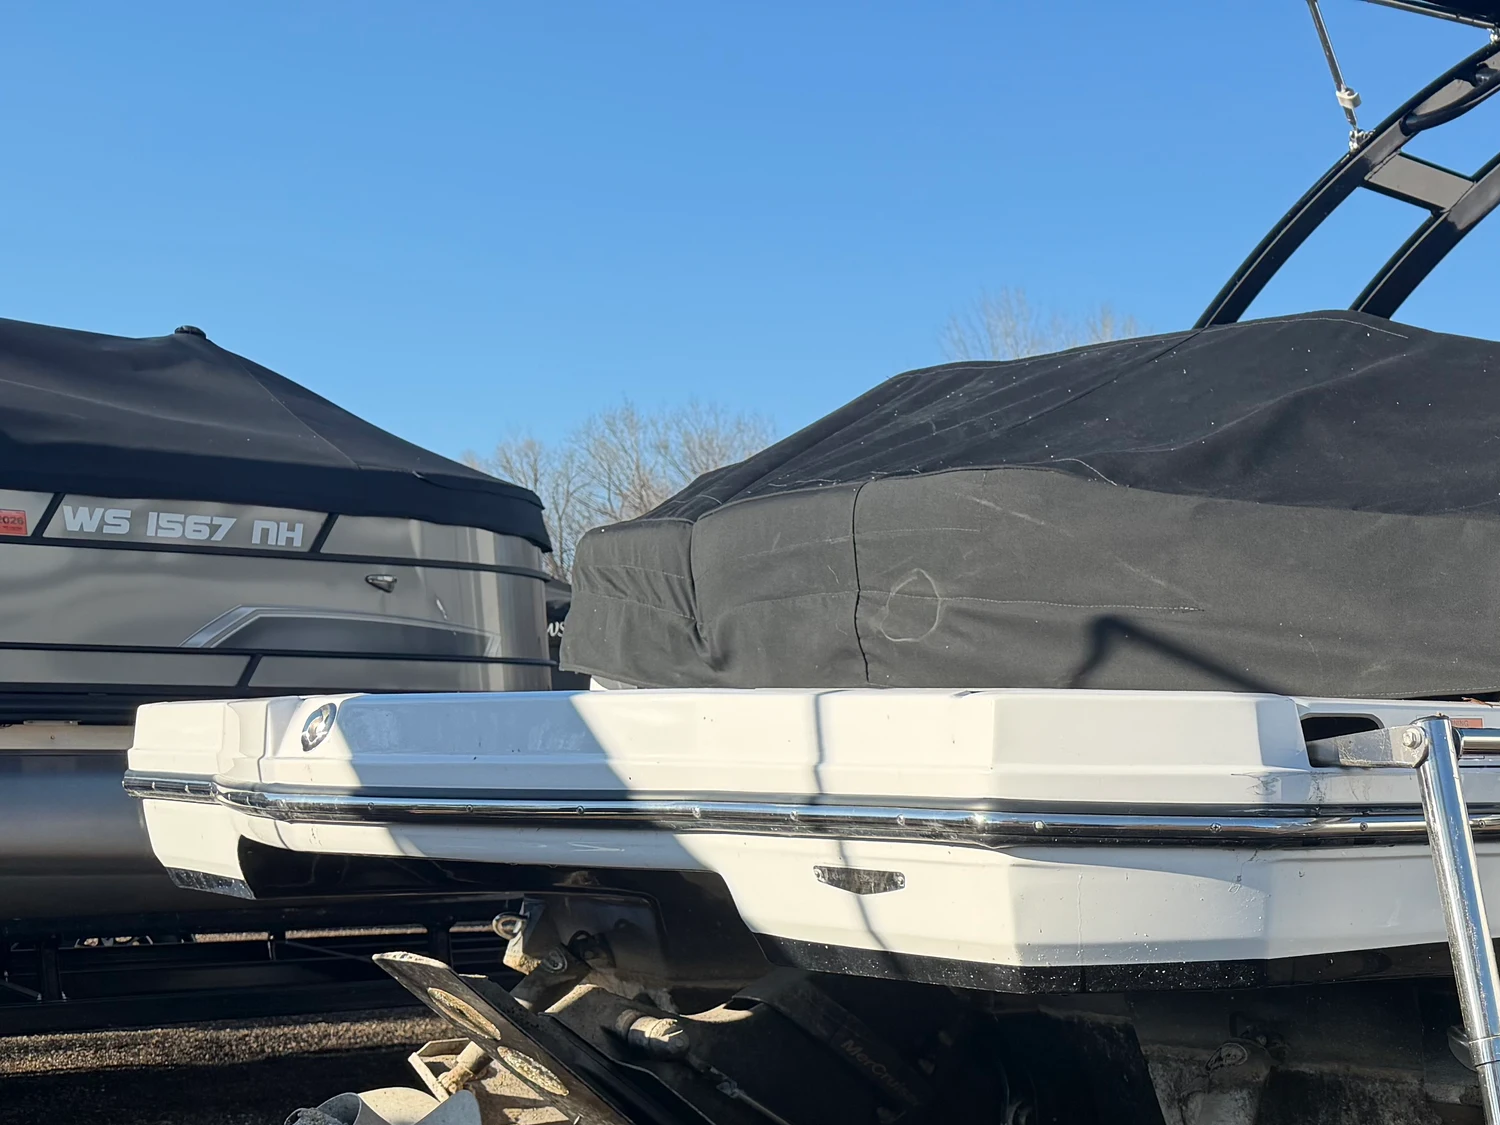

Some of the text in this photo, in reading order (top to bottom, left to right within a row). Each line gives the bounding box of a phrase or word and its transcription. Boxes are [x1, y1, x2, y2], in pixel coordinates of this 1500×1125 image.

[63, 505, 304, 547] WS 1567 NH
